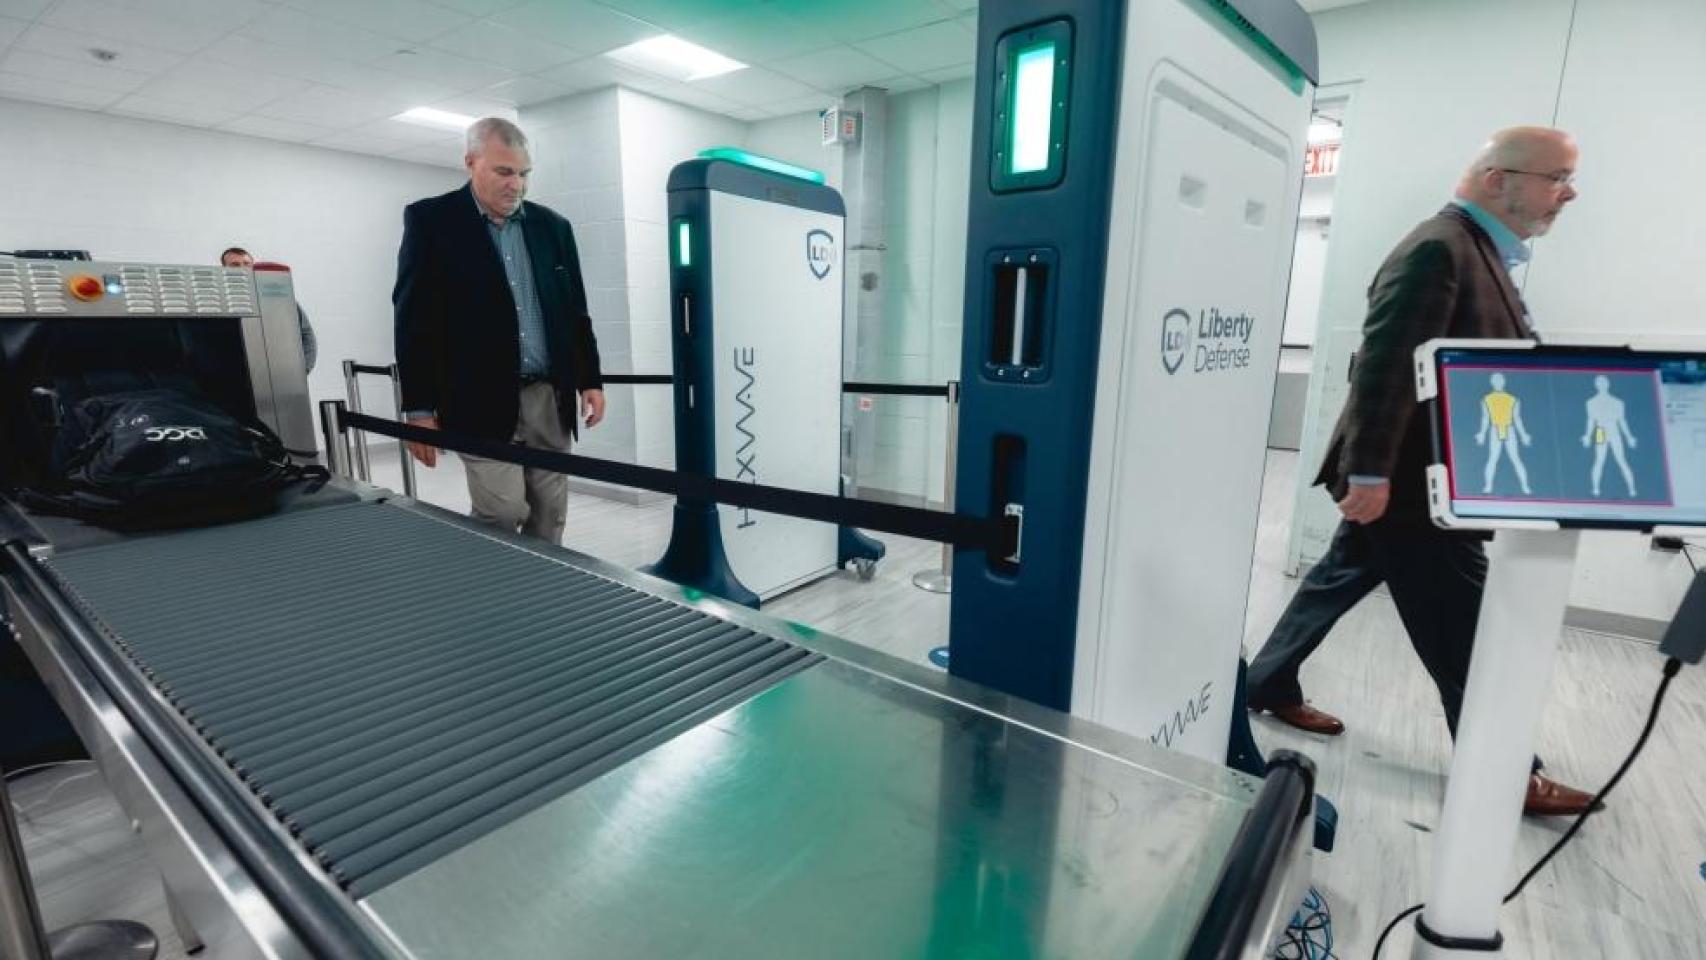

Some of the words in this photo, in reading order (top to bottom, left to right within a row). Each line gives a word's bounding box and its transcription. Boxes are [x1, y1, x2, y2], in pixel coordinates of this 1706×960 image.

[1304, 144, 1341, 174] EXIT
[1198, 307, 1255, 344] Liberty
[1194, 342, 1250, 373] Defense
[733, 346, 756, 529] HXWAVE
